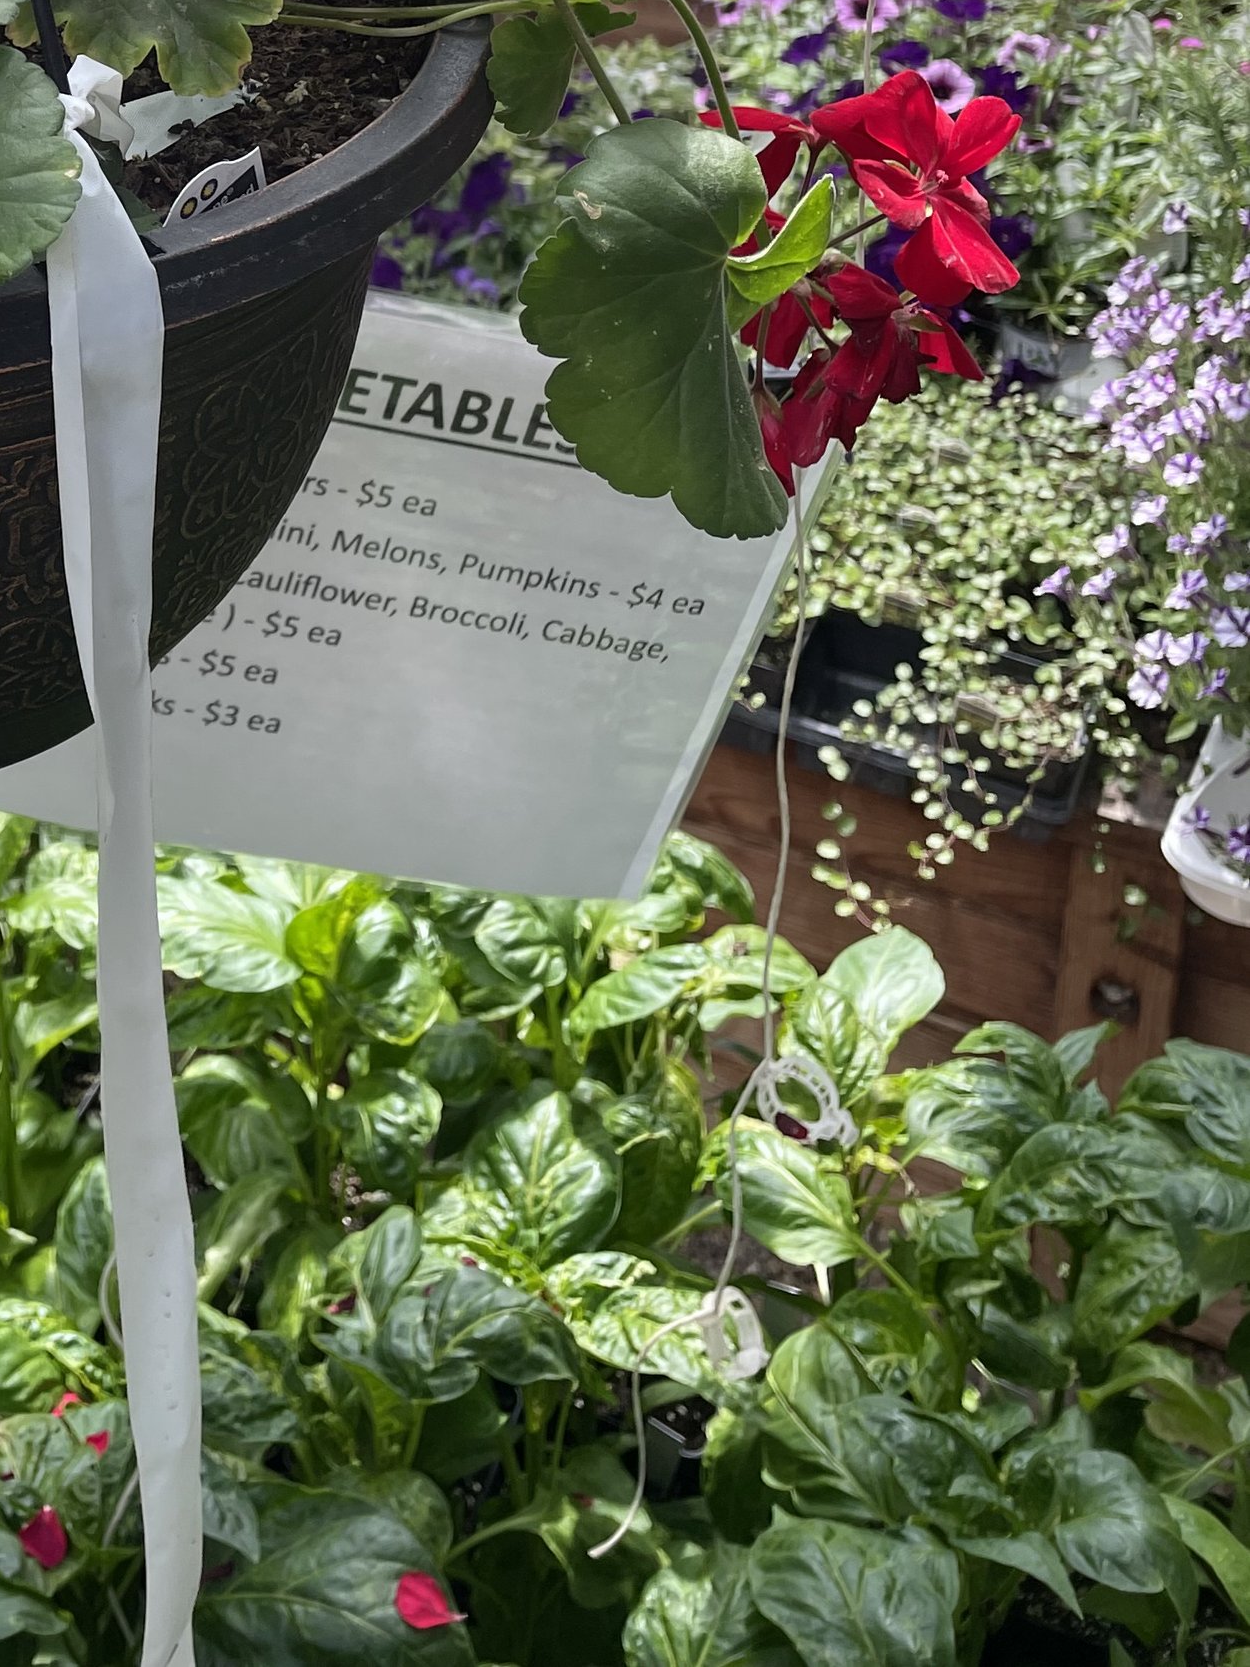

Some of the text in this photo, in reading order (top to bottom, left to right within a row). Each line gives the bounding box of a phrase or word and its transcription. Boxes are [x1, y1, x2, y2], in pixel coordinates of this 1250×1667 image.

[338, 368, 576, 455] ETABLE
[355, 479, 395, 508] $5
[402, 494, 438, 516] ea
[269, 519, 320, 552] ini,
[331, 530, 447, 575] Melons,
[458, 553, 602, 599] Pumpkins
[626, 582, 665, 610] $4
[672, 595, 705, 615] ea
[236, 570, 670, 664] auliflower, Broccoli, Cabbage,
[261, 610, 301, 638] $5
[307, 625, 342, 646] ea
[198, 649, 237, 676] $5
[243, 663, 279, 684] ea
[202, 700, 240, 726] $3
[247, 713, 282, 734] ea
